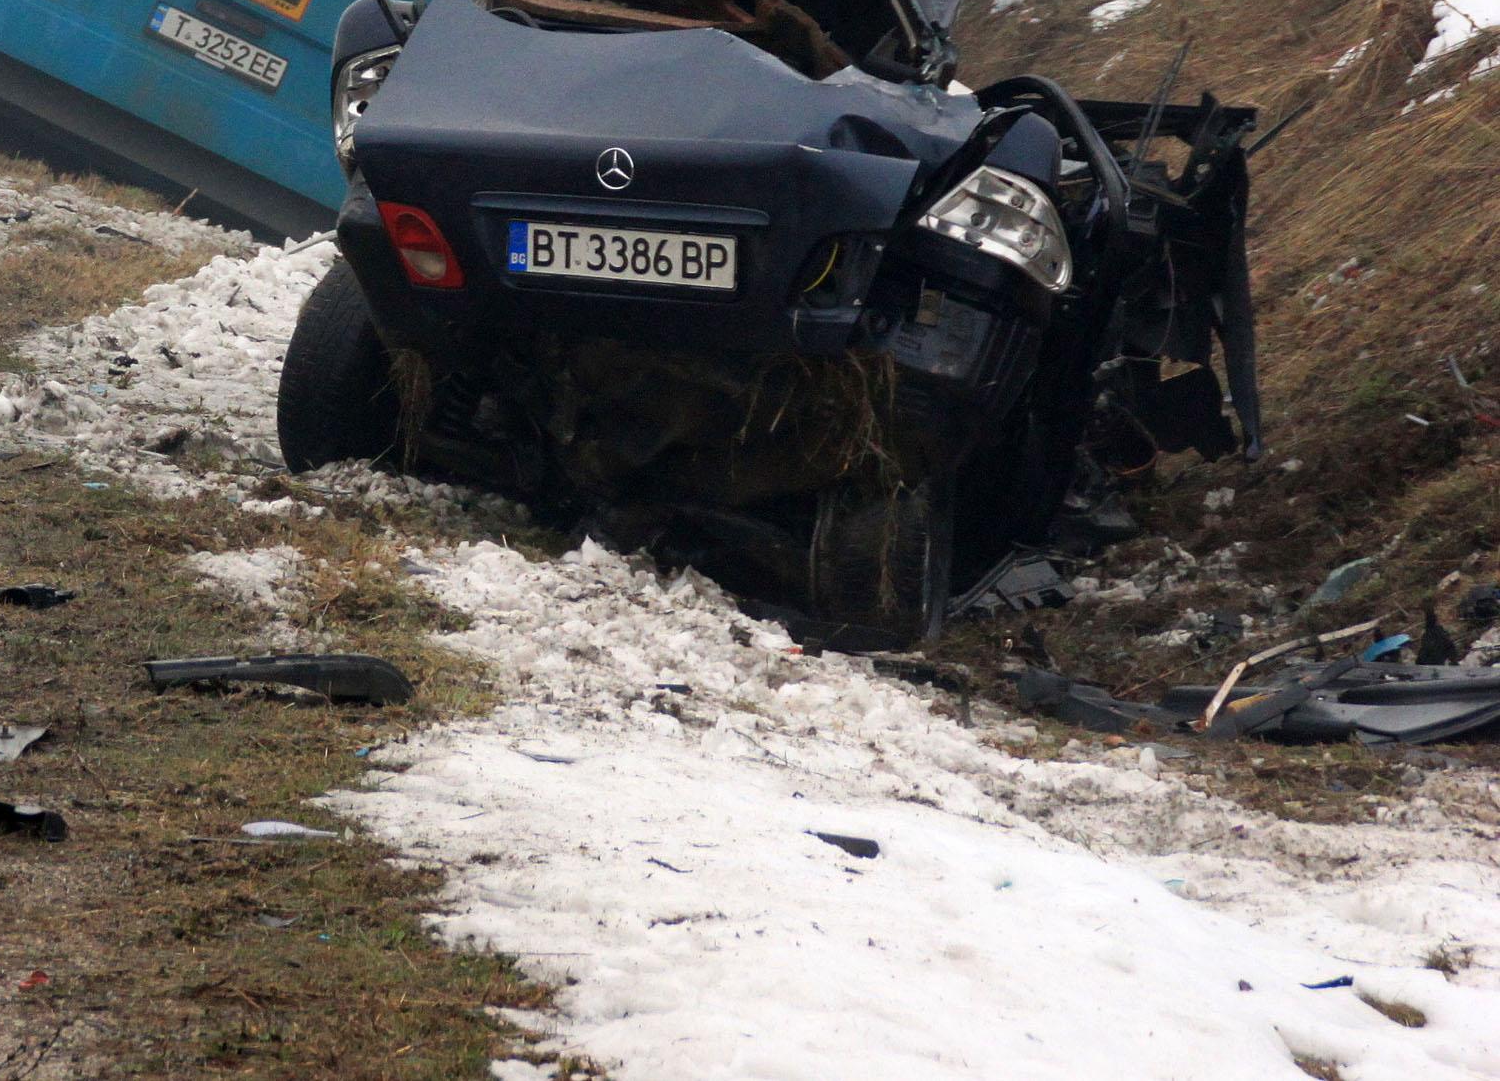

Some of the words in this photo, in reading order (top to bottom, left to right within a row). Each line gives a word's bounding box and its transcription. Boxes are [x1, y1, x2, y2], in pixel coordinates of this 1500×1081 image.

[174, 14, 191, 37] T
[194, 27, 251, 69] 3252
[249, 52, 283, 82] EE
[510, 252, 526, 265] BG
[532, 228, 580, 269] BT
[586, 233, 673, 277] 3386
[681, 240, 728, 281] BP
